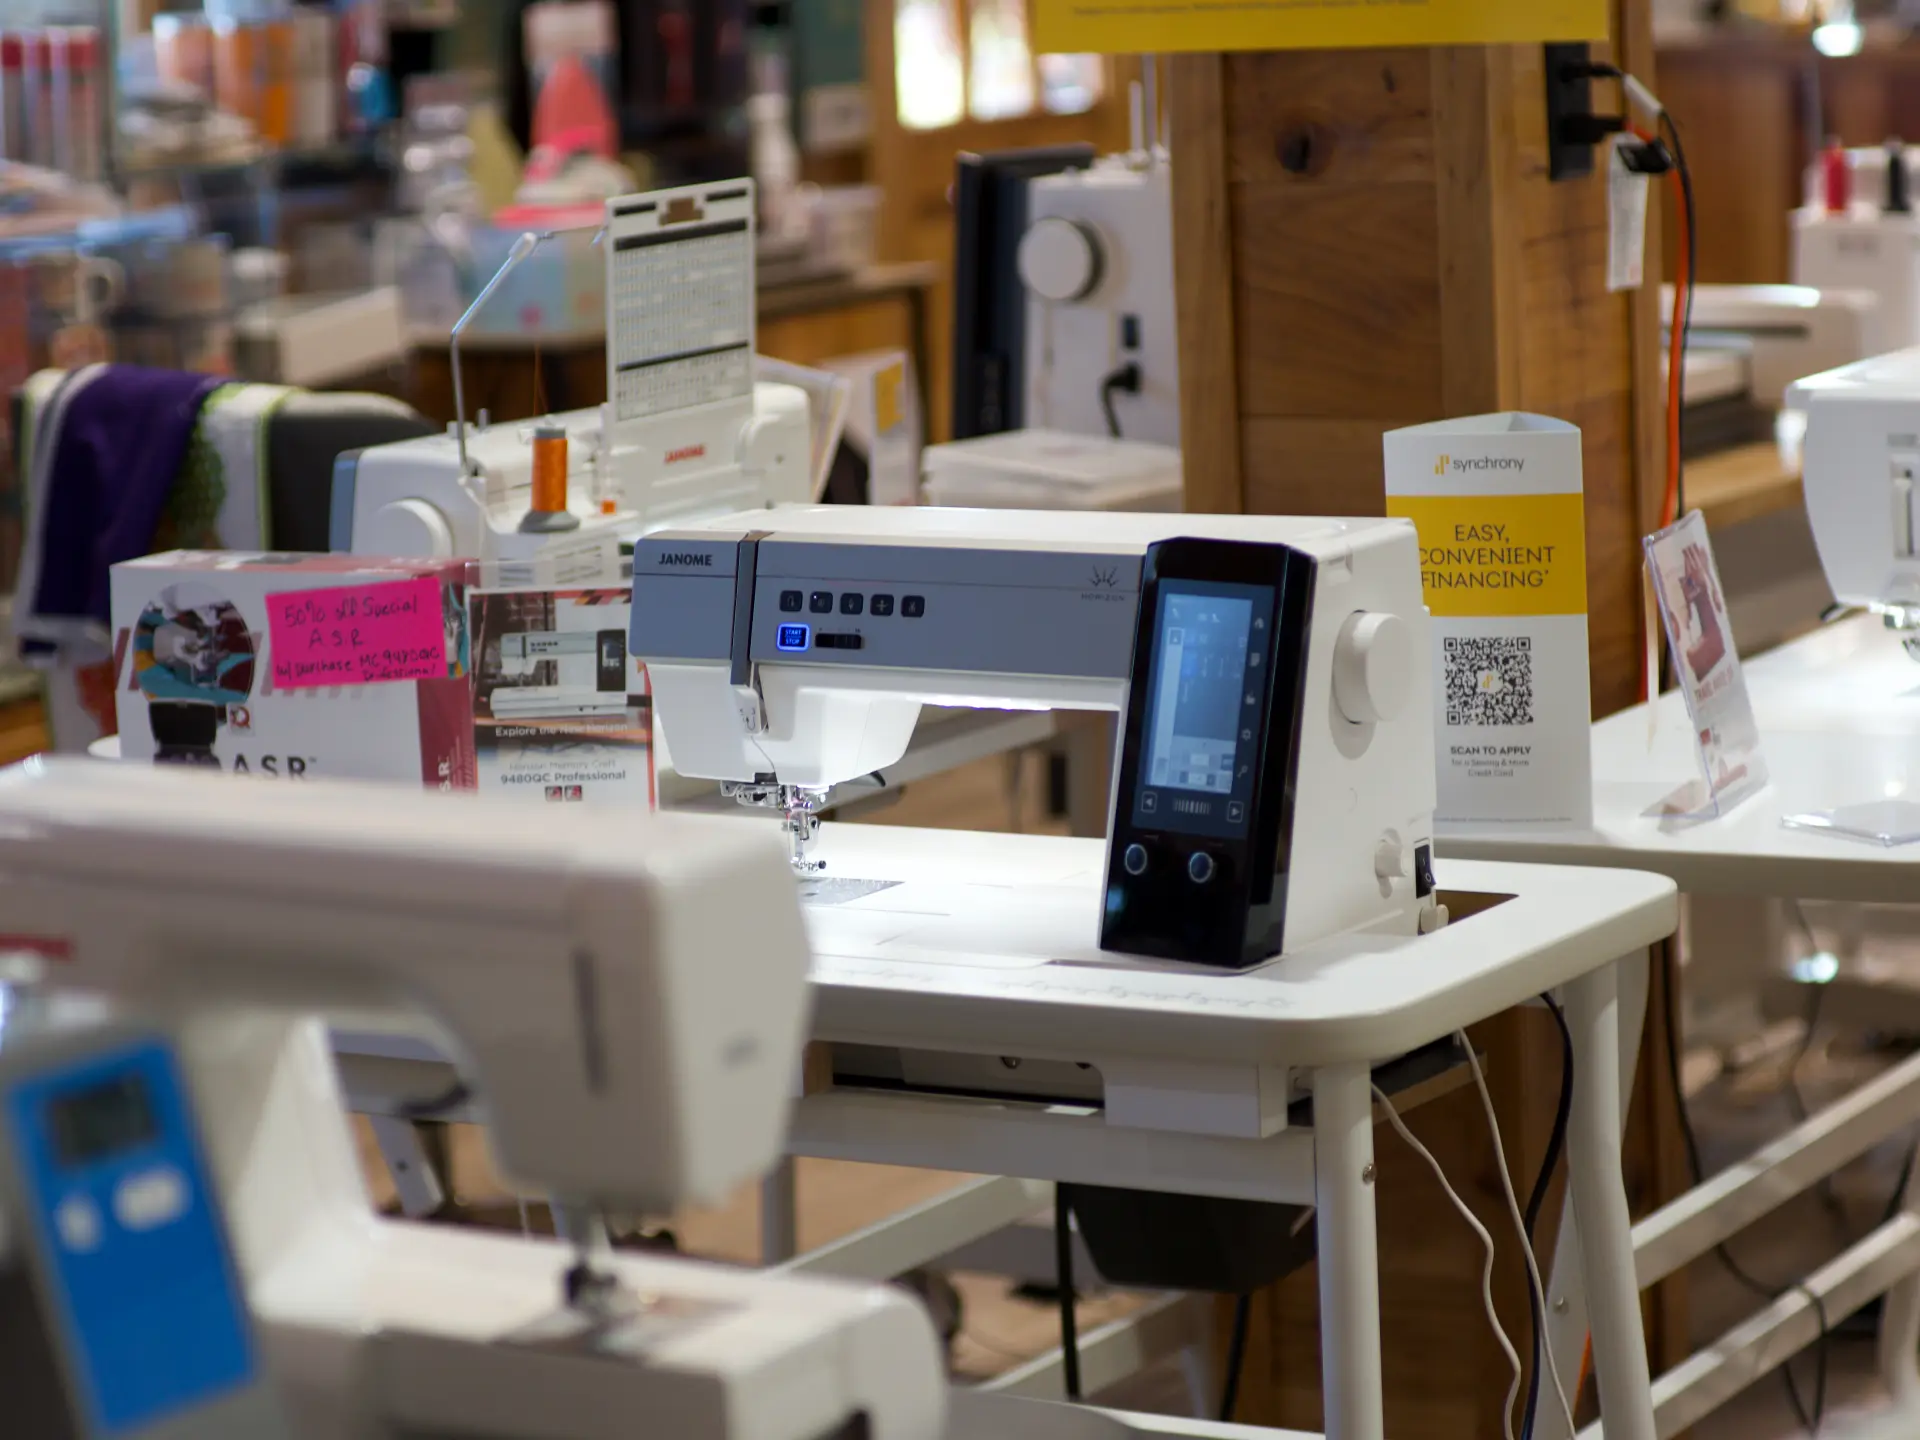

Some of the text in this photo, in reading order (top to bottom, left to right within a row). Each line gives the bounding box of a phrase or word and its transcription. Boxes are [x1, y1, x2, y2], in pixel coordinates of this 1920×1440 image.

[1453, 456, 1525, 473] synchrony
[1455, 524, 1510, 543] EASY,
[658, 553, 713, 566] JANOME
[1419, 546, 1555, 565] CONVENIENT
[1081, 593, 1125, 602] HORIZON
[285, 599, 326, 627] 50%
[785, 638, 801, 646] STOP
[495, 726, 537, 738] Explore
[539, 726, 557, 735] the
[1450, 746, 1532, 755] SCAN TO APPLY
[501, 770, 626, 785] 9480QC Professional
